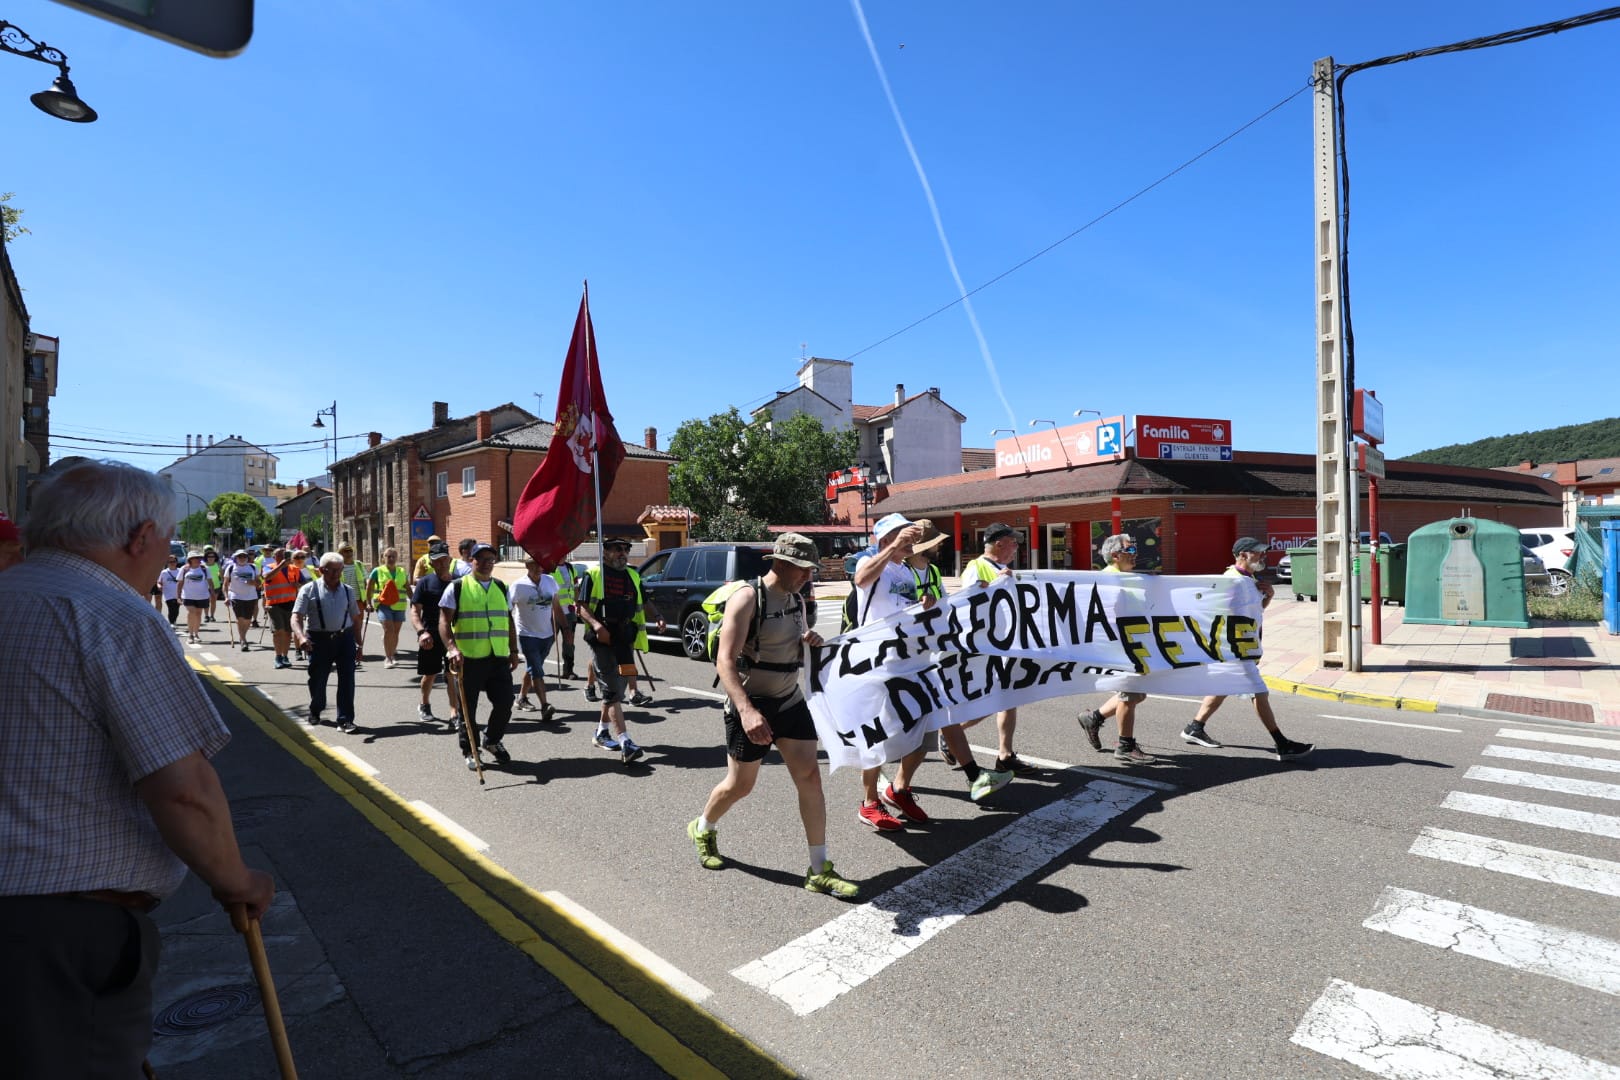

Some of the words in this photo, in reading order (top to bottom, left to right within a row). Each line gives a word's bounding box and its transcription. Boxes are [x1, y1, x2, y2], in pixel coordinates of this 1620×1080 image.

[1098, 425, 1115, 451] P
[1161, 445, 1171, 458] P
[810, 581, 1117, 693] PLATAFORMA
[1116, 615, 1262, 675] FEVE
